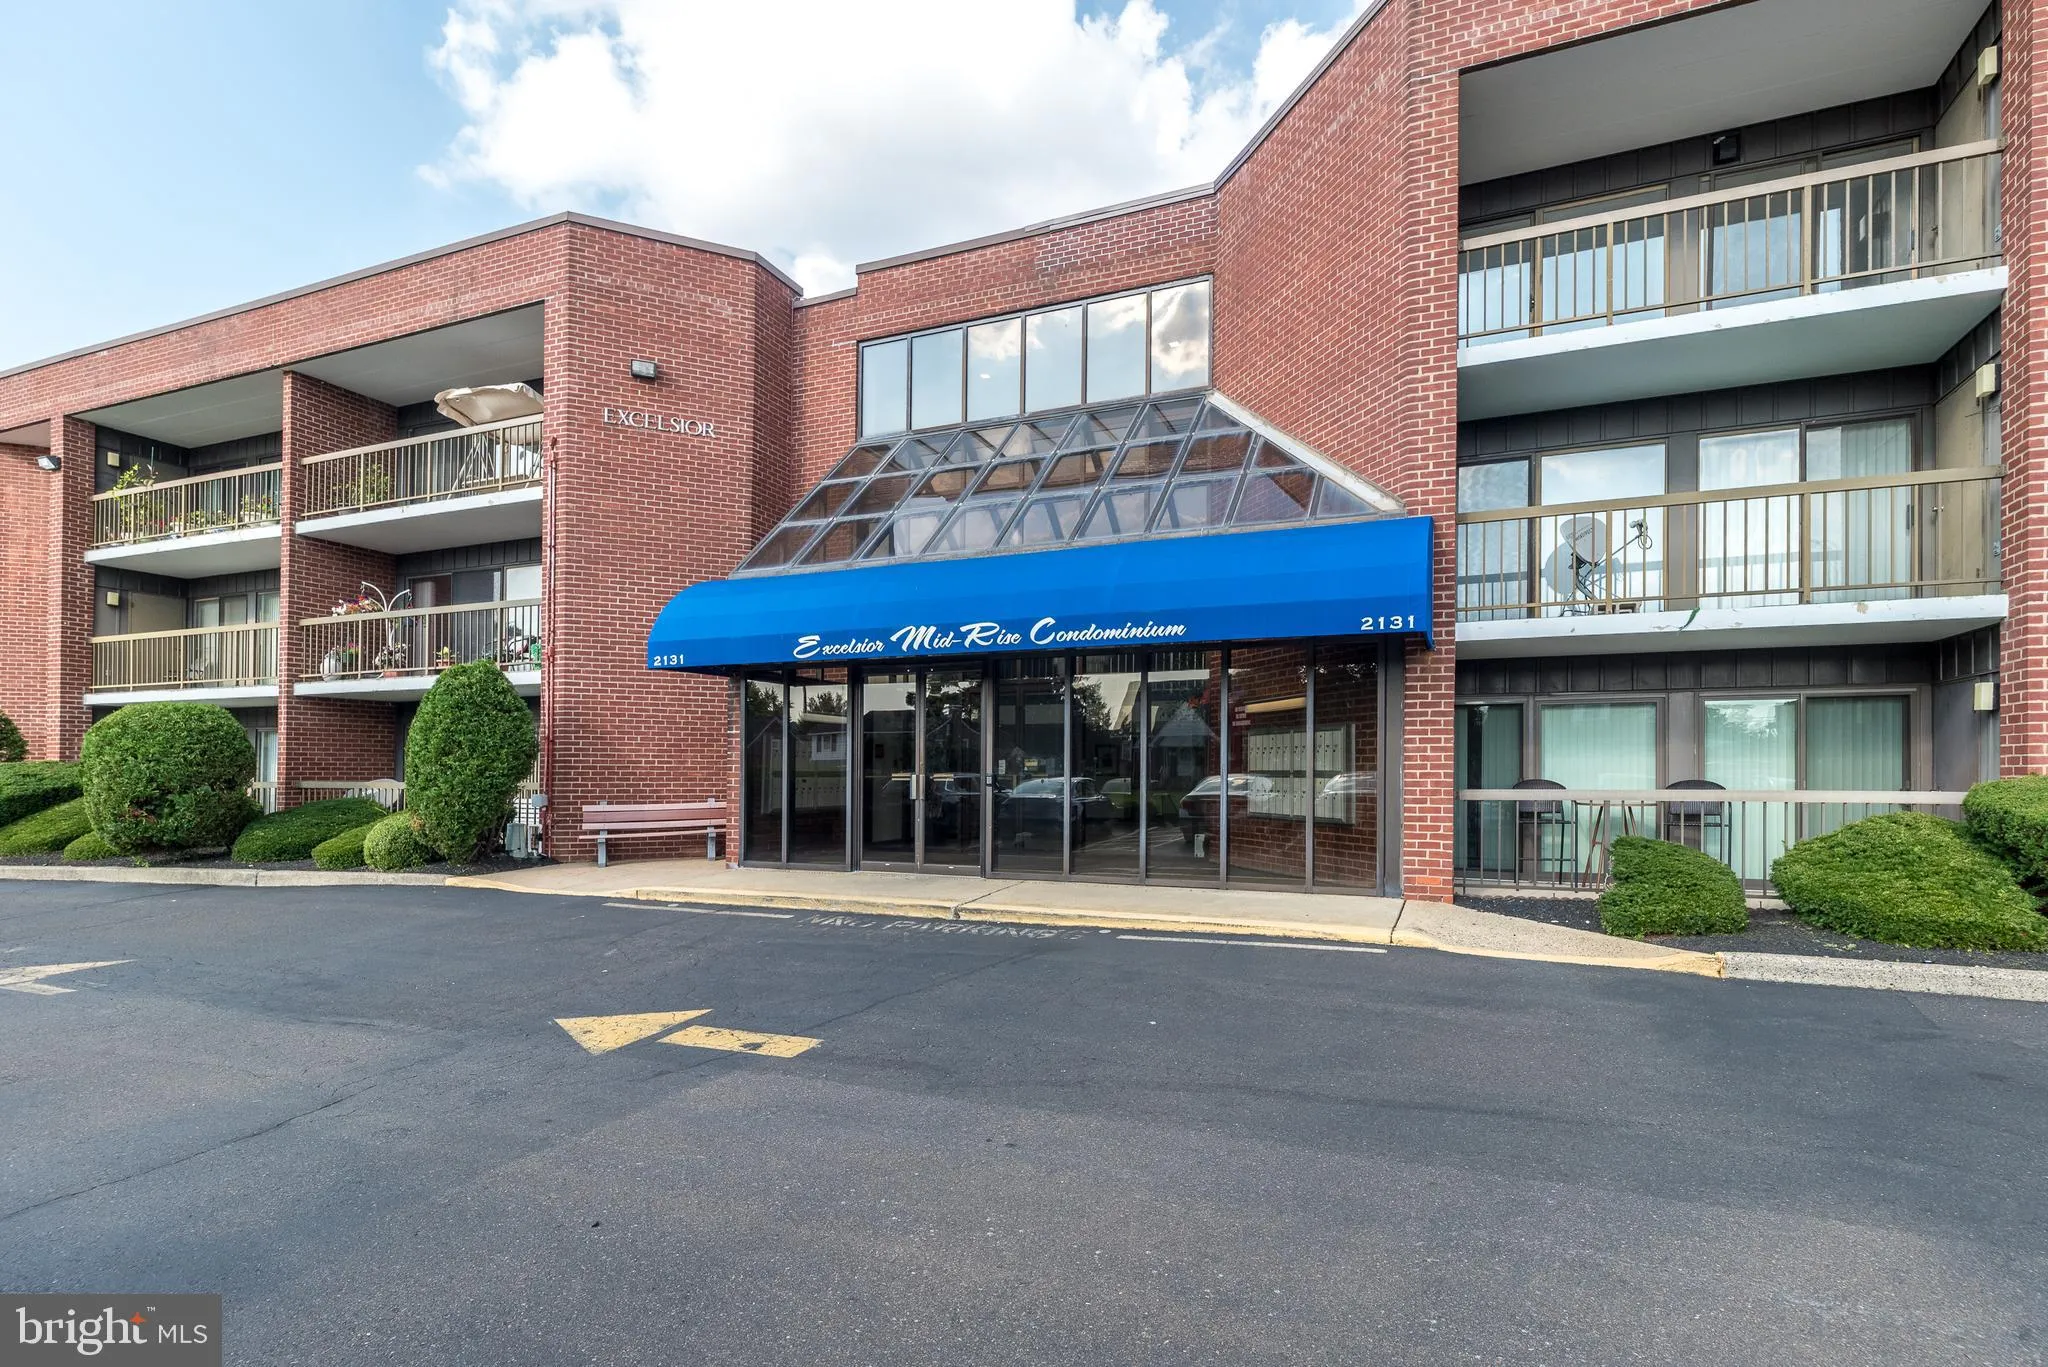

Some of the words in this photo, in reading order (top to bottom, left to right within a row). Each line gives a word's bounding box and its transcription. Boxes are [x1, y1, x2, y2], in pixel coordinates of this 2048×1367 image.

[603, 407, 716, 438] EXCELSIOR
[1360, 614, 1415, 631] 2131
[793, 635, 885, 659] Excelsior
[890, 621, 1022, 652] Mid-Rise
[1029, 616, 1188, 645] Condominium
[653, 653, 684, 667] 2131
